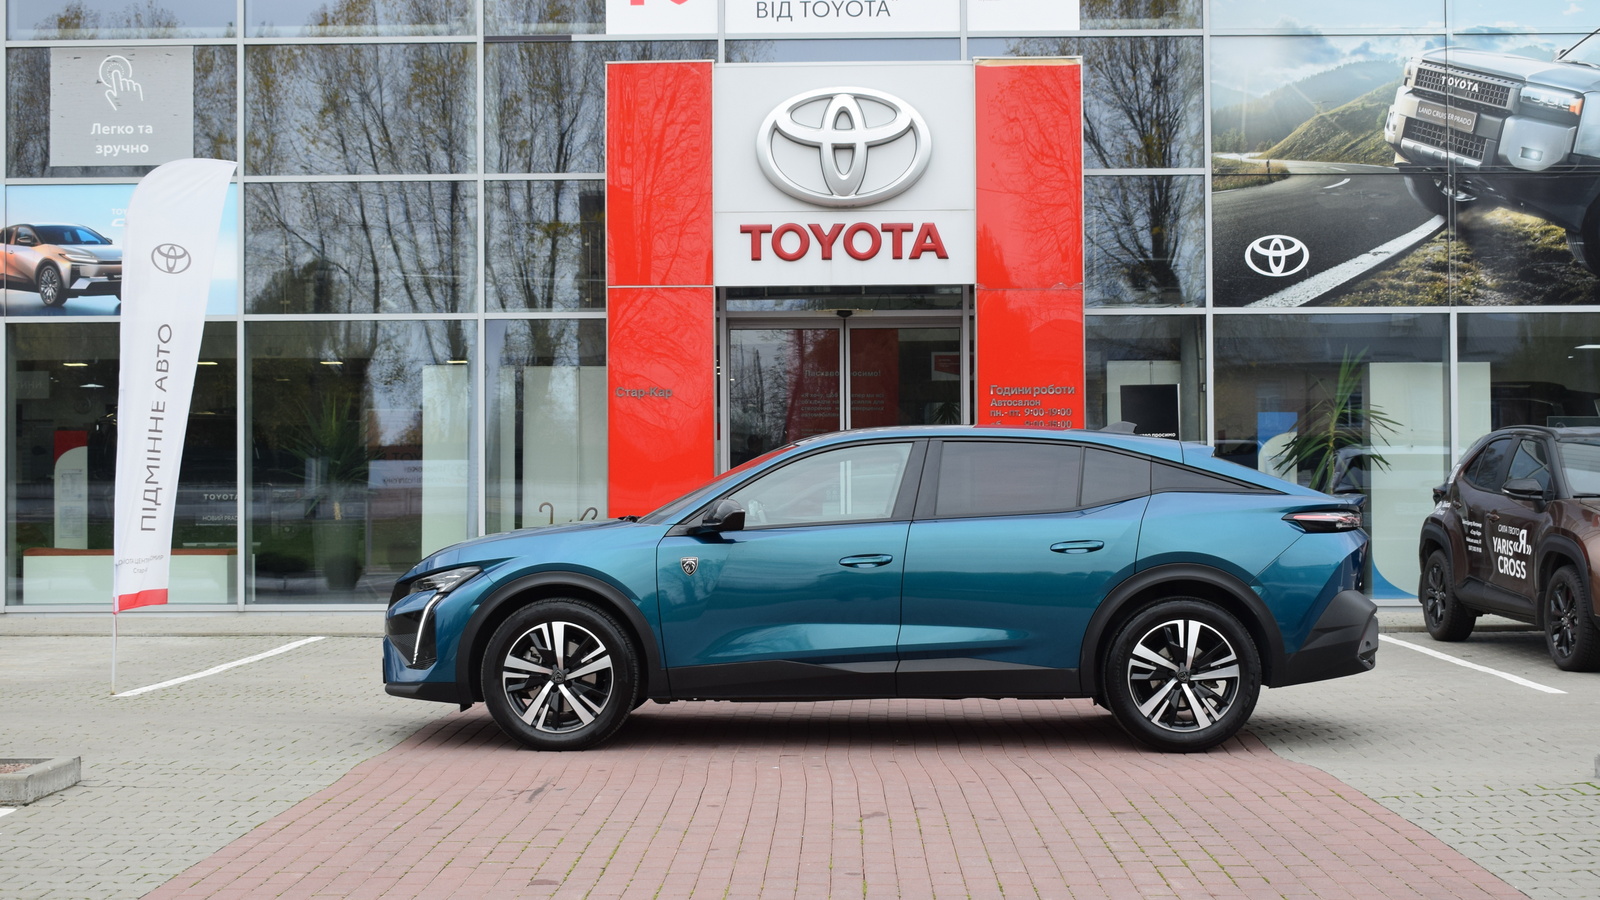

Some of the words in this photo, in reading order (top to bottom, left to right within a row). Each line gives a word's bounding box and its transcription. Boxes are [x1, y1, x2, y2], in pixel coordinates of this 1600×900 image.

[756, 1, 793, 22] ВІД
[800, 0, 891, 18] TOYOTA
[1441, 76, 1479, 93] TOYOTA
[1418, 106, 1432, 116] LAND
[1432, 110, 1454, 120] CRUISER
[1454, 115, 1472, 126] PRADO
[90, 123, 134, 135] Легко
[137, 124, 153, 134] та
[95, 144, 149, 157] зручно
[739, 222, 949, 261] TOYOTA
[615, 386, 673, 399] Стар-Кар
[989, 384, 1032, 396] Години
[1033, 384, 1075, 397] роботи
[990, 398, 1041, 407] Автосалон
[140, 400, 166, 532] ПІДМІННЕ
[154, 323, 173, 393] АВТО
[1492, 536, 1514, 556] YARIS
[1497, 555, 1527, 580] CROSS
